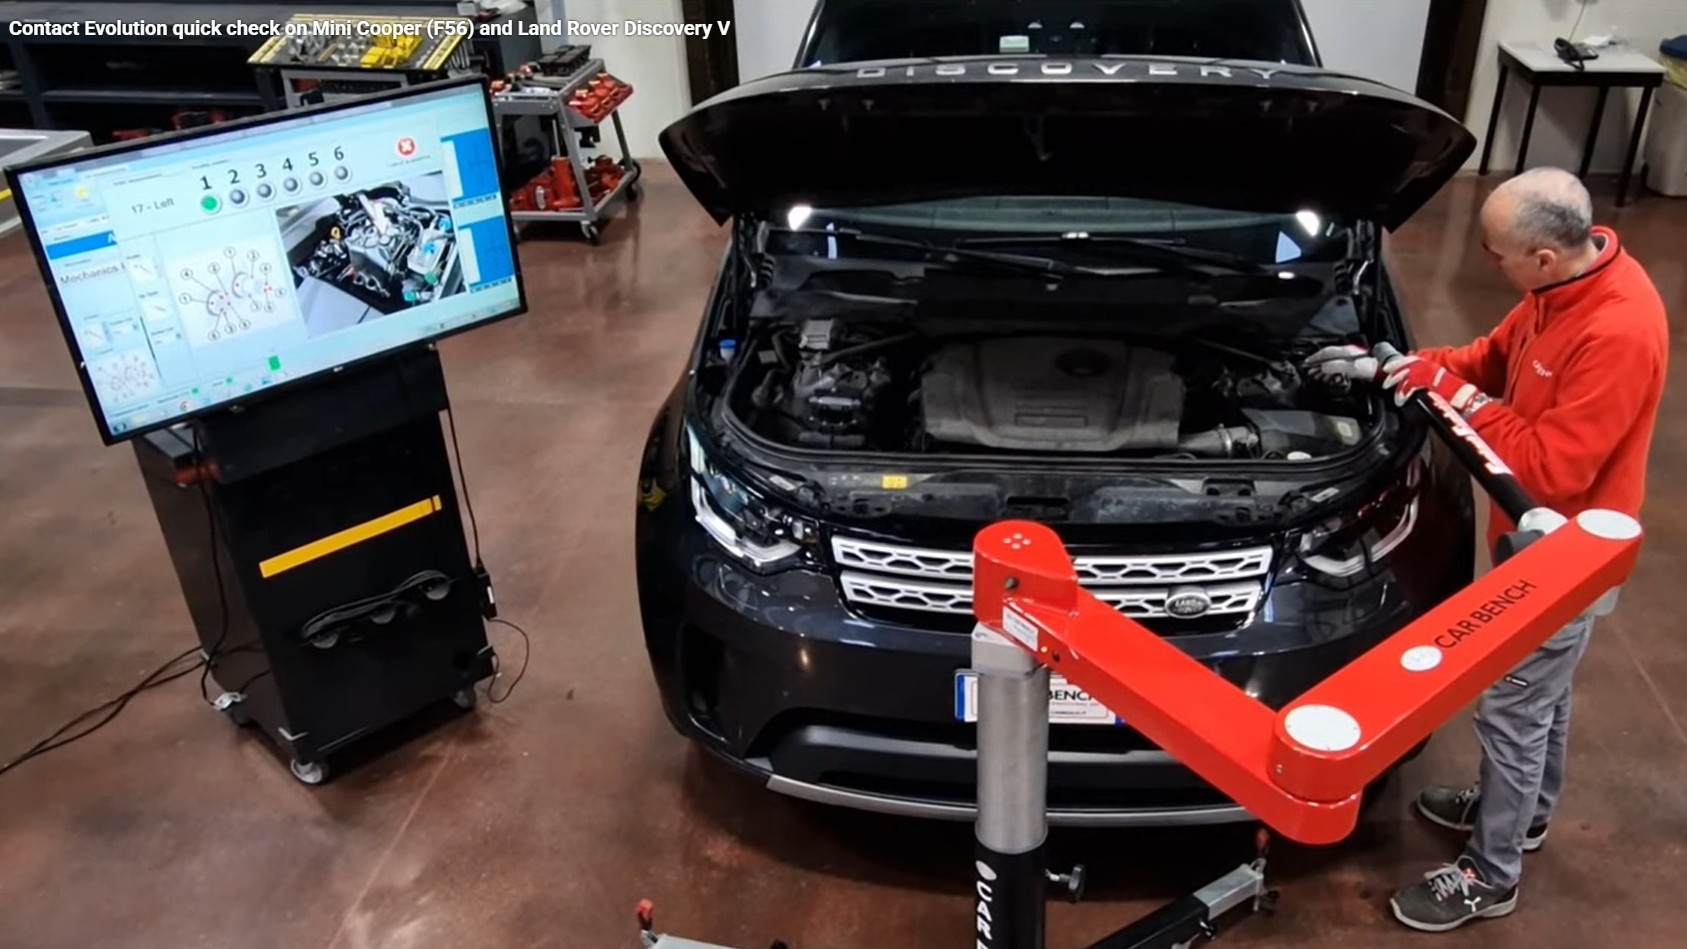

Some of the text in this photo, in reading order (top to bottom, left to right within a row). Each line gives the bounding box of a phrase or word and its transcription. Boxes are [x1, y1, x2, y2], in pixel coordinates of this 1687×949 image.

[856, 62, 1276, 80] DISCOVERY
[201, 145, 345, 190] 1 2 3 4 5 6
[60, 264, 119, 284] Mechanics
[1433, 579, 1538, 649] CAR BENCH
[1047, 689, 1092, 701] BENC
[976, 880, 993, 940] CAR
